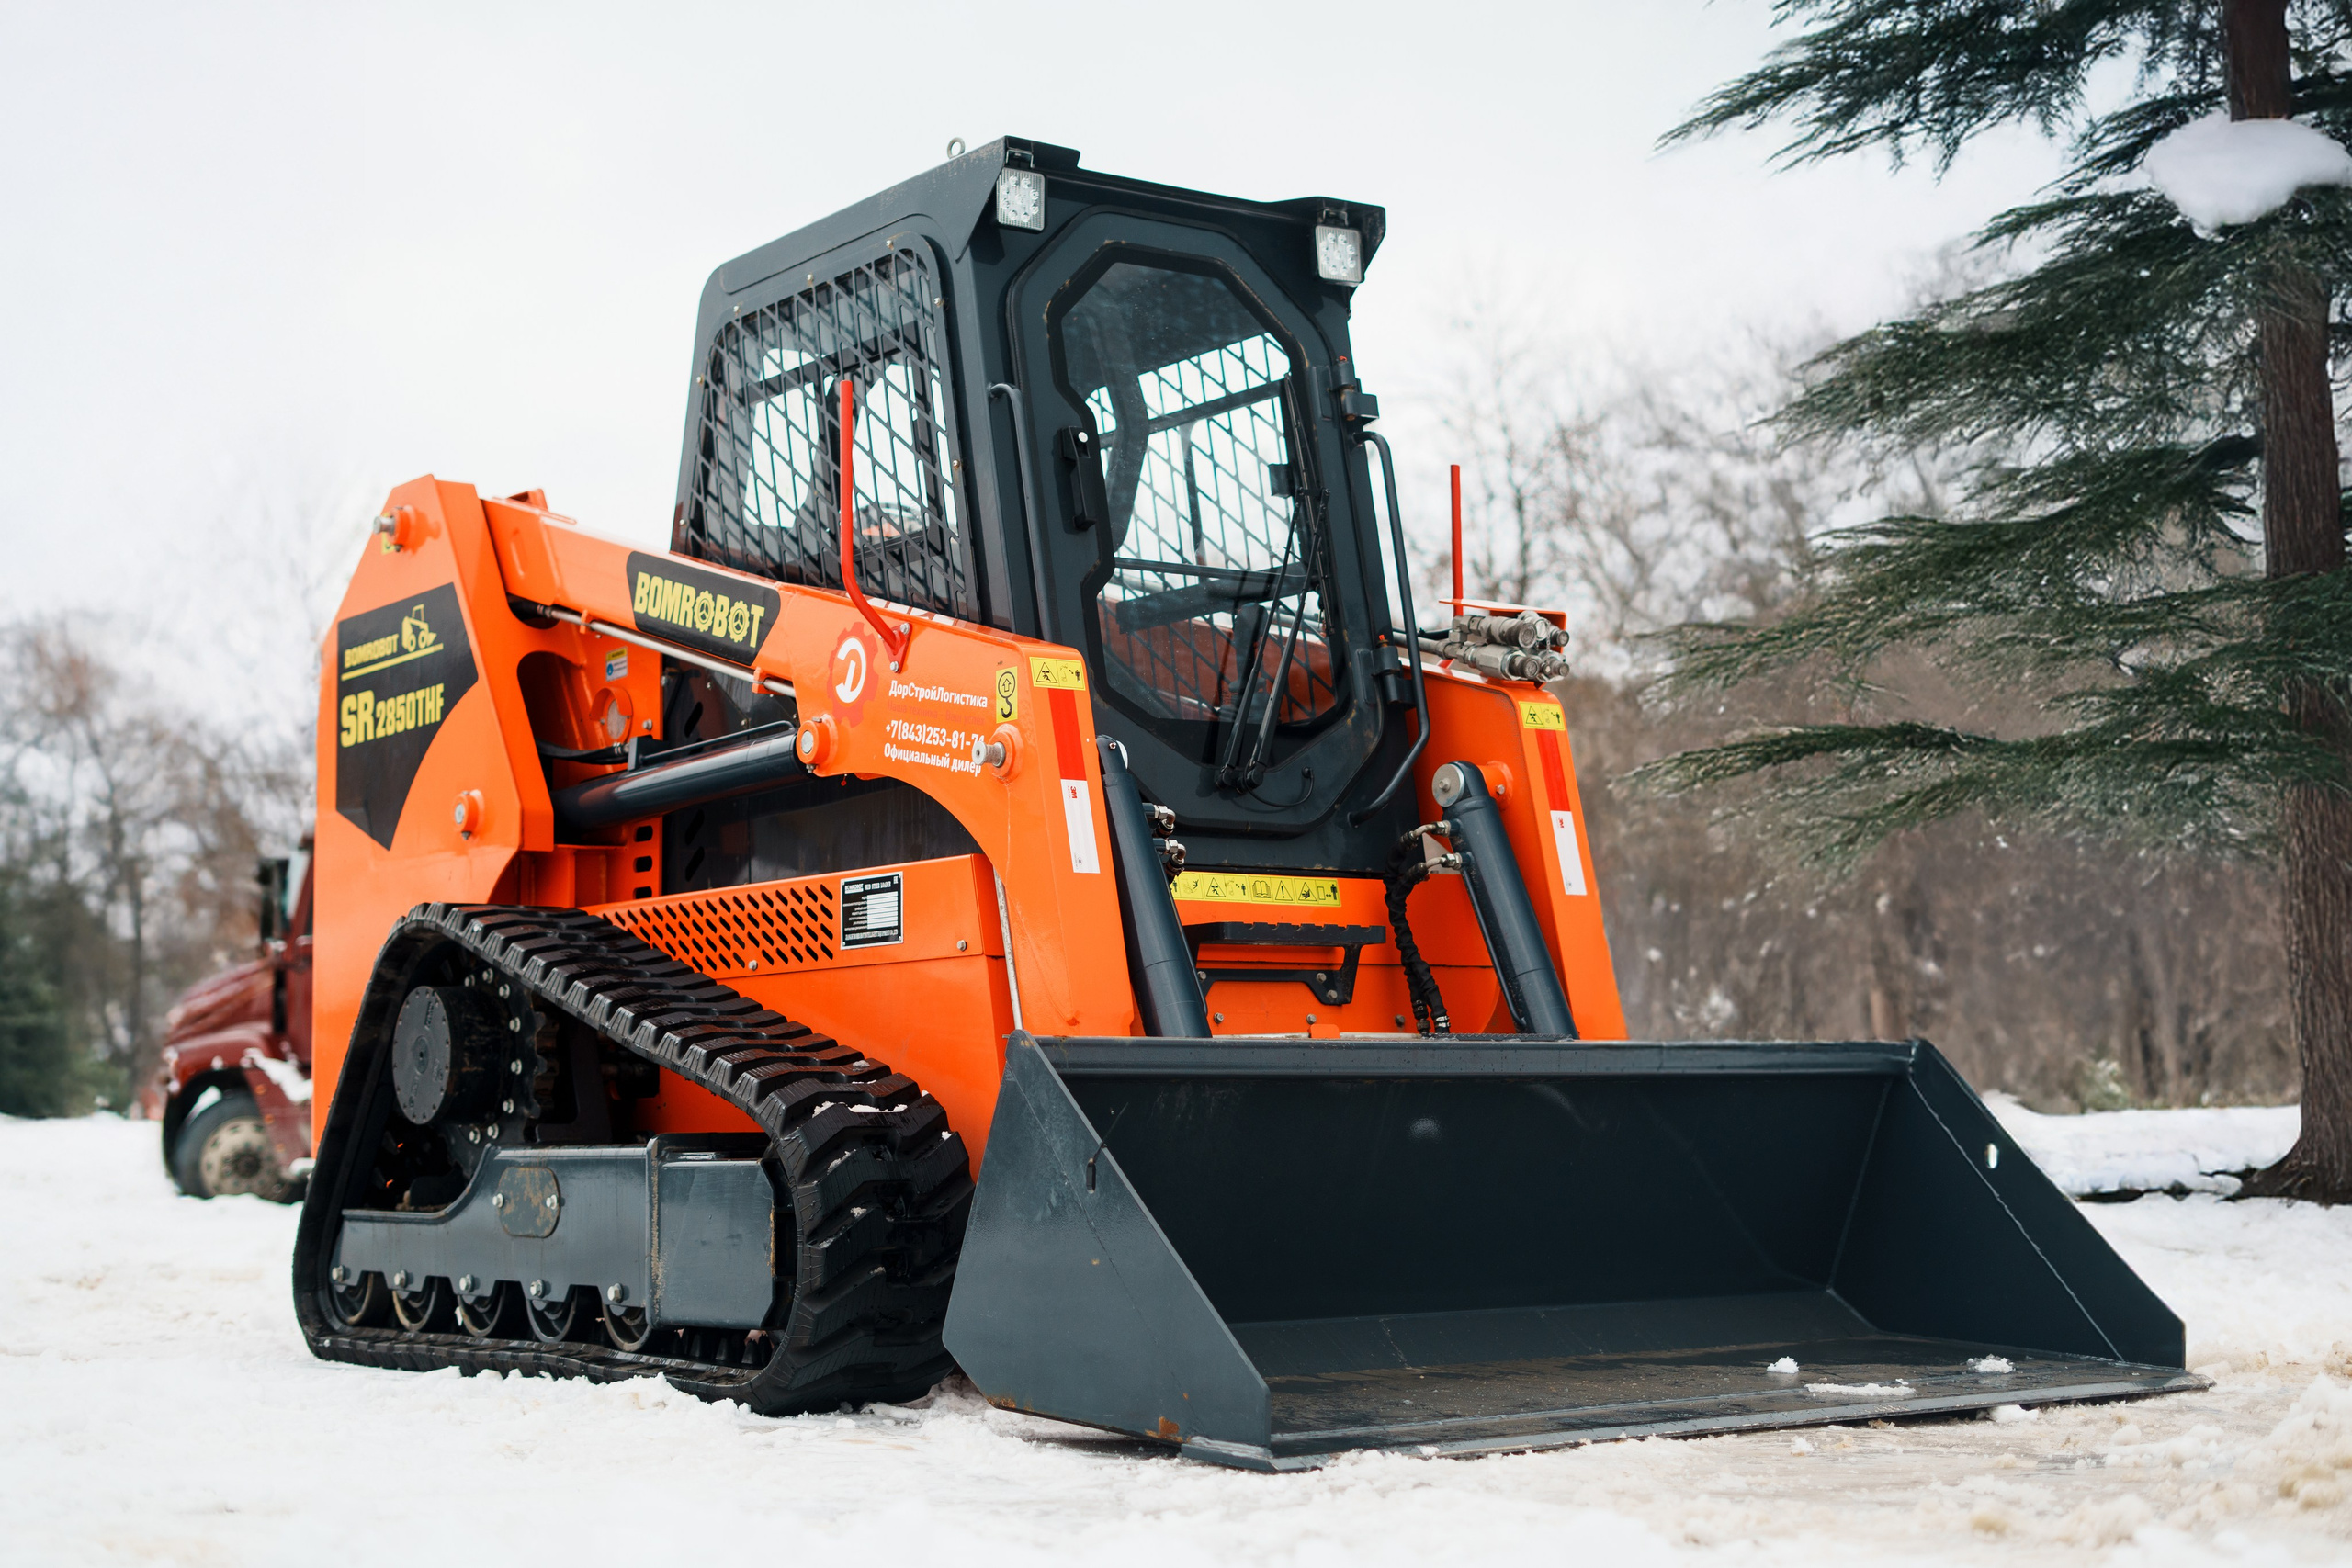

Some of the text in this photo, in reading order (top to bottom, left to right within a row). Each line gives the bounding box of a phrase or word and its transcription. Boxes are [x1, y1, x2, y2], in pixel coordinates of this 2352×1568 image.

[633, 570, 765, 649] BOMROBOT
[344, 632, 400, 669] BOMROBOT
[888, 680, 989, 708] ДорСтройЛогистика
[883, 742, 982, 778] Официальный дилер
[1070, 786, 1078, 799] 3M
